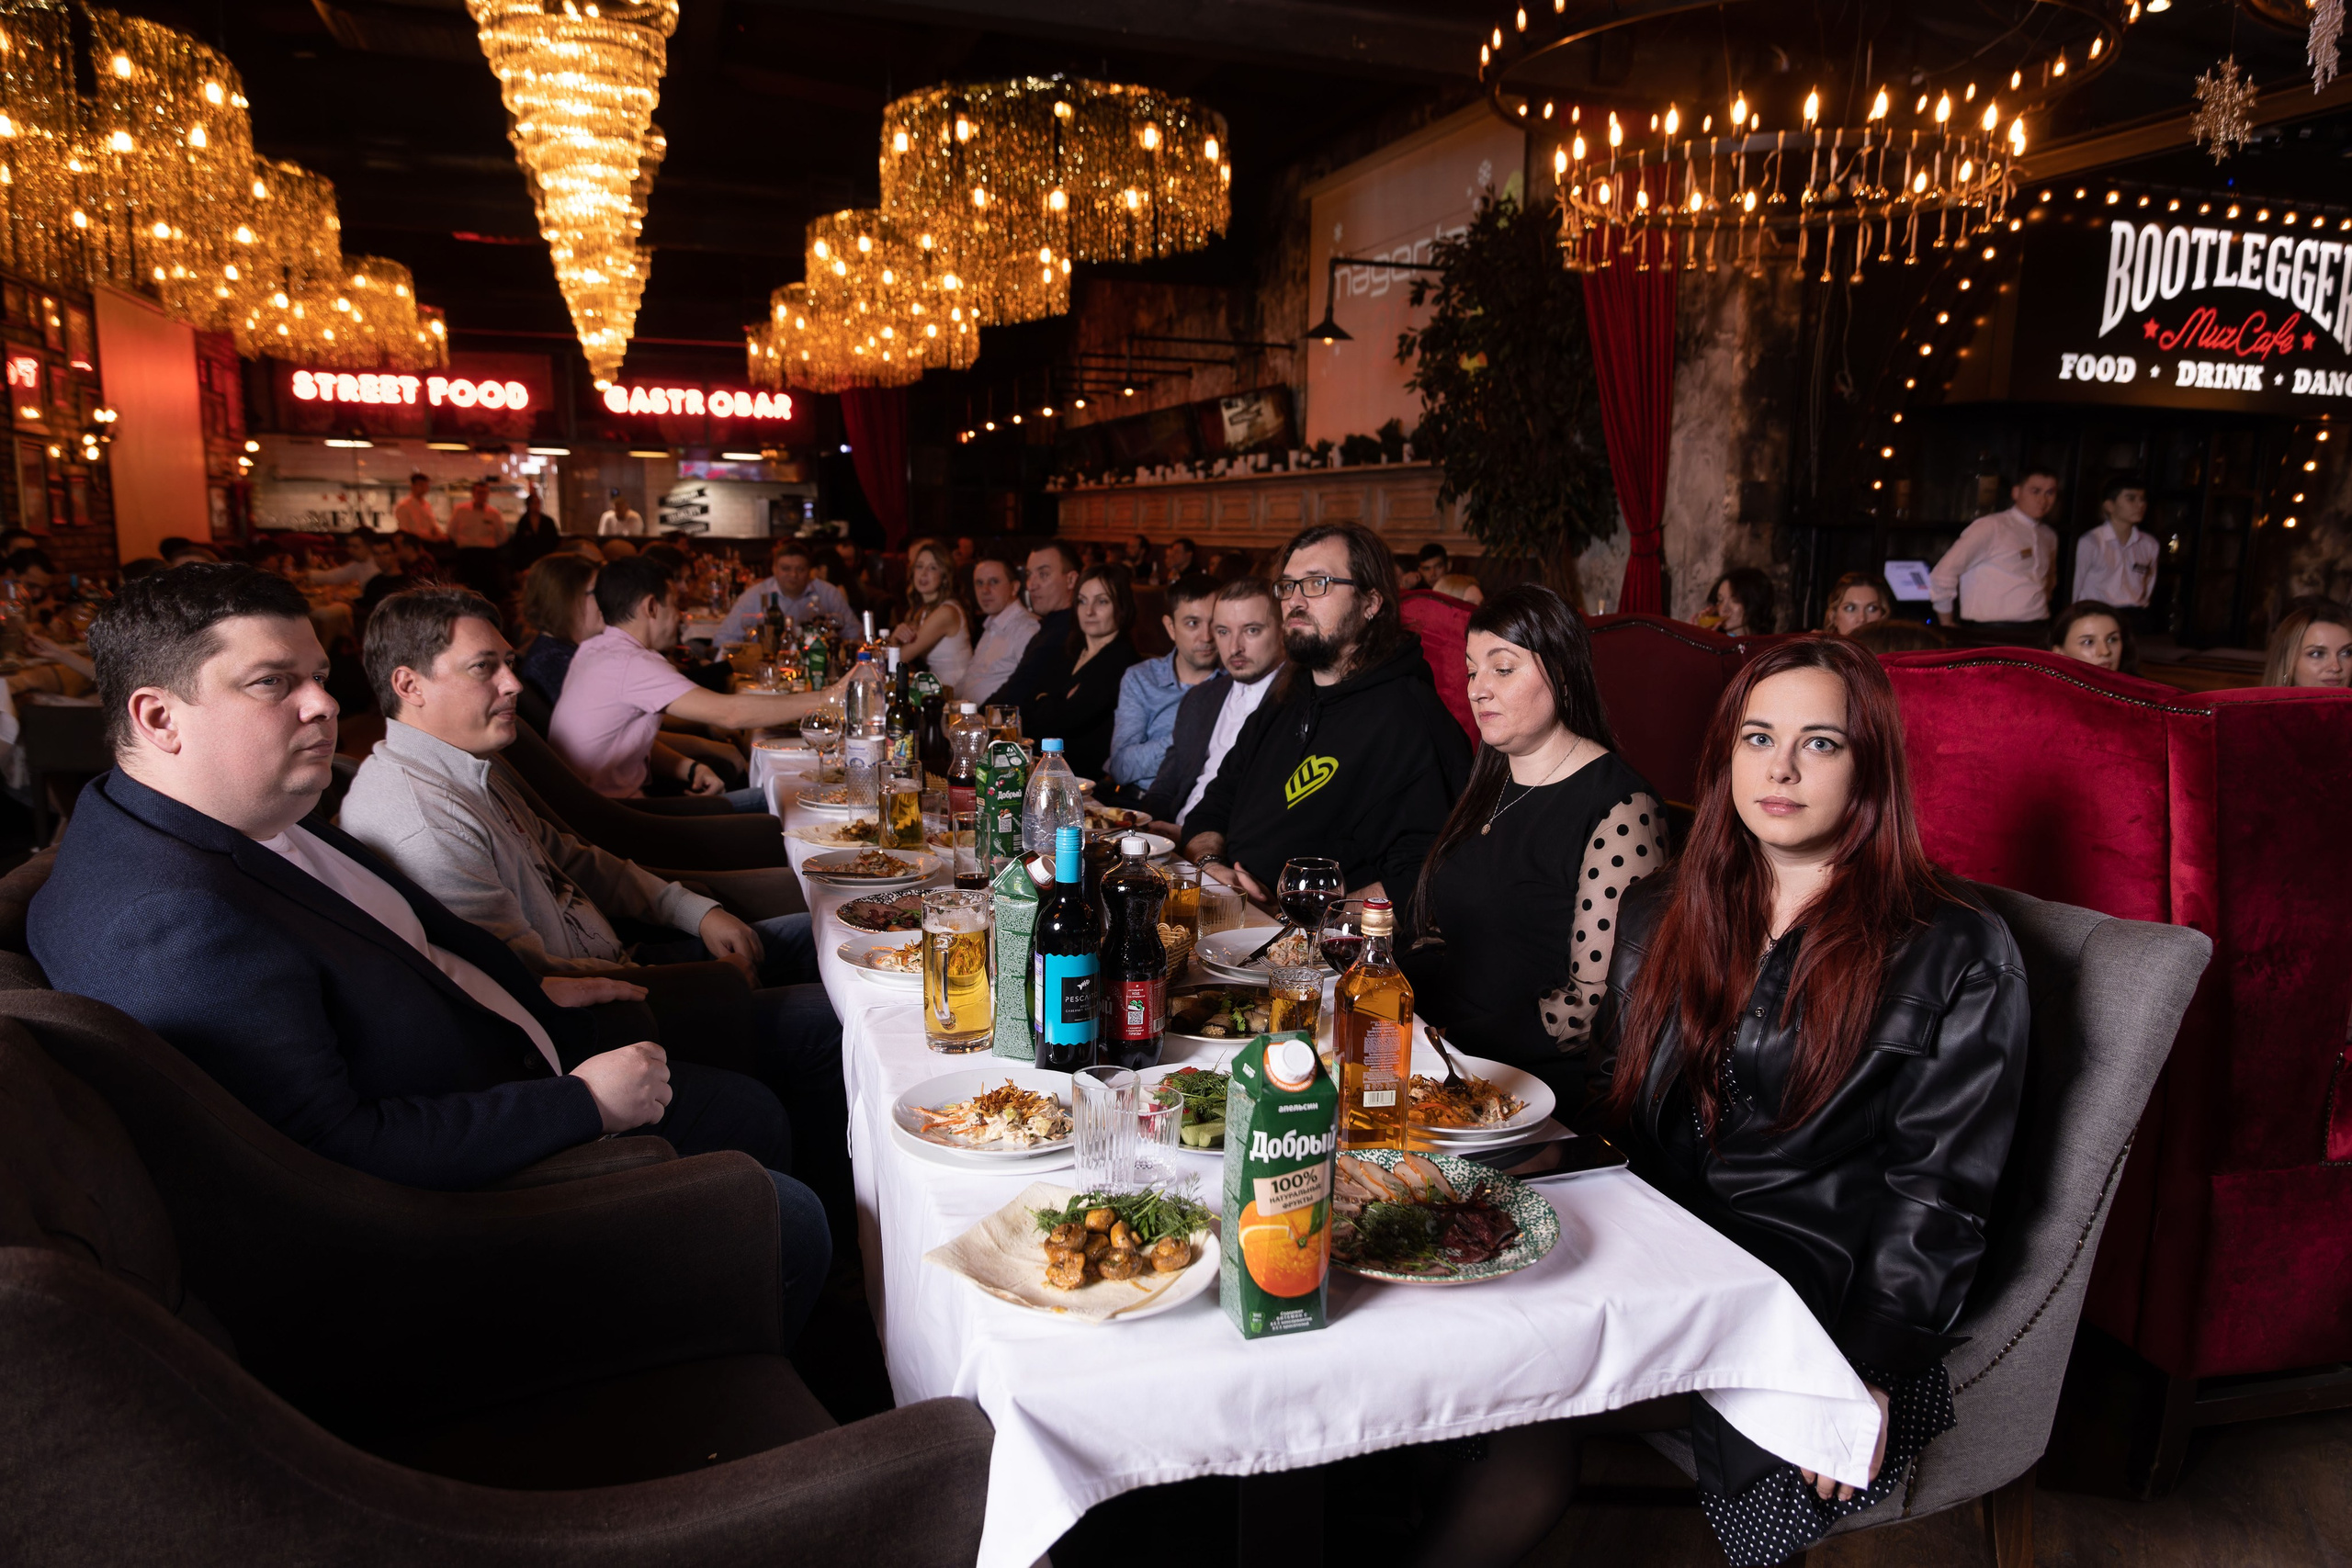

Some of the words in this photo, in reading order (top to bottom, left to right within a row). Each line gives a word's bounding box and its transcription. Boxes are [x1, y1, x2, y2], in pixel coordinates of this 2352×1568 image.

[2059, 353, 2137, 383] FOOD
[2176, 360, 2265, 391] DRINK
[292, 370, 422, 404] STREET
[426, 377, 529, 410] FOOD
[998, 789, 1023, 800] Добрый
[1278, 1102, 1318, 1113] апельсин
[1250, 1124, 1337, 1164] Добрый
[1272, 1168, 1317, 1193] 100%
[1270, 1184, 1321, 1203] НАТУРАЛЬНЫЕ
[1283, 1195, 1314, 1209] ФРУКТЫ
